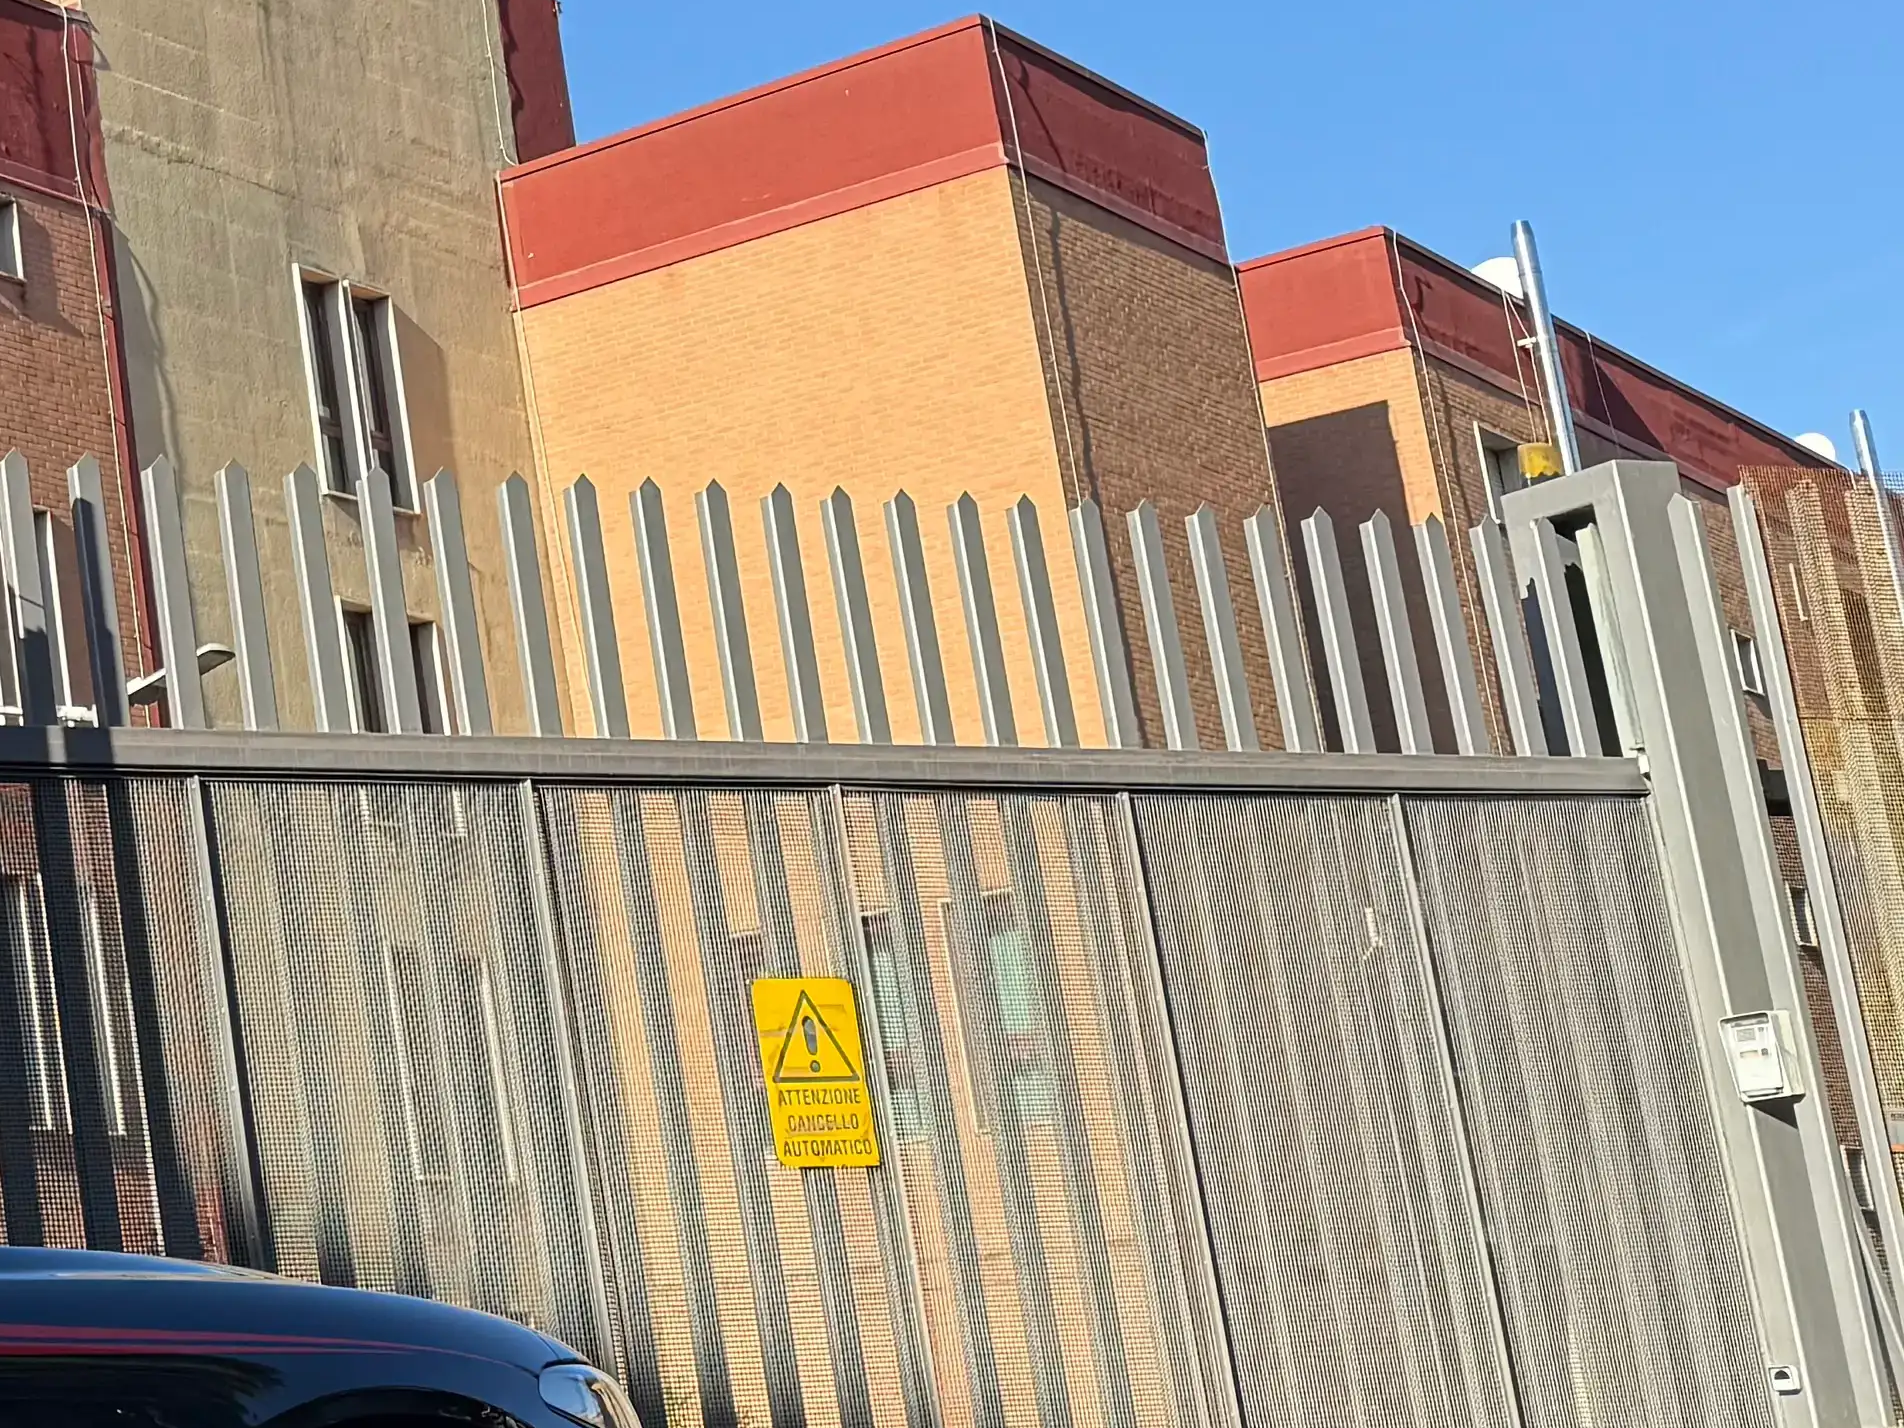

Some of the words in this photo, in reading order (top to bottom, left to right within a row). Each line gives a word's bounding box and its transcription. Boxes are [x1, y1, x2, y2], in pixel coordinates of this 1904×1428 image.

[778, 1087, 862, 1107] ATTENZIONE
[787, 1113, 860, 1133] CANCELLO
[783, 1138, 873, 1158] AUTOMATICO
